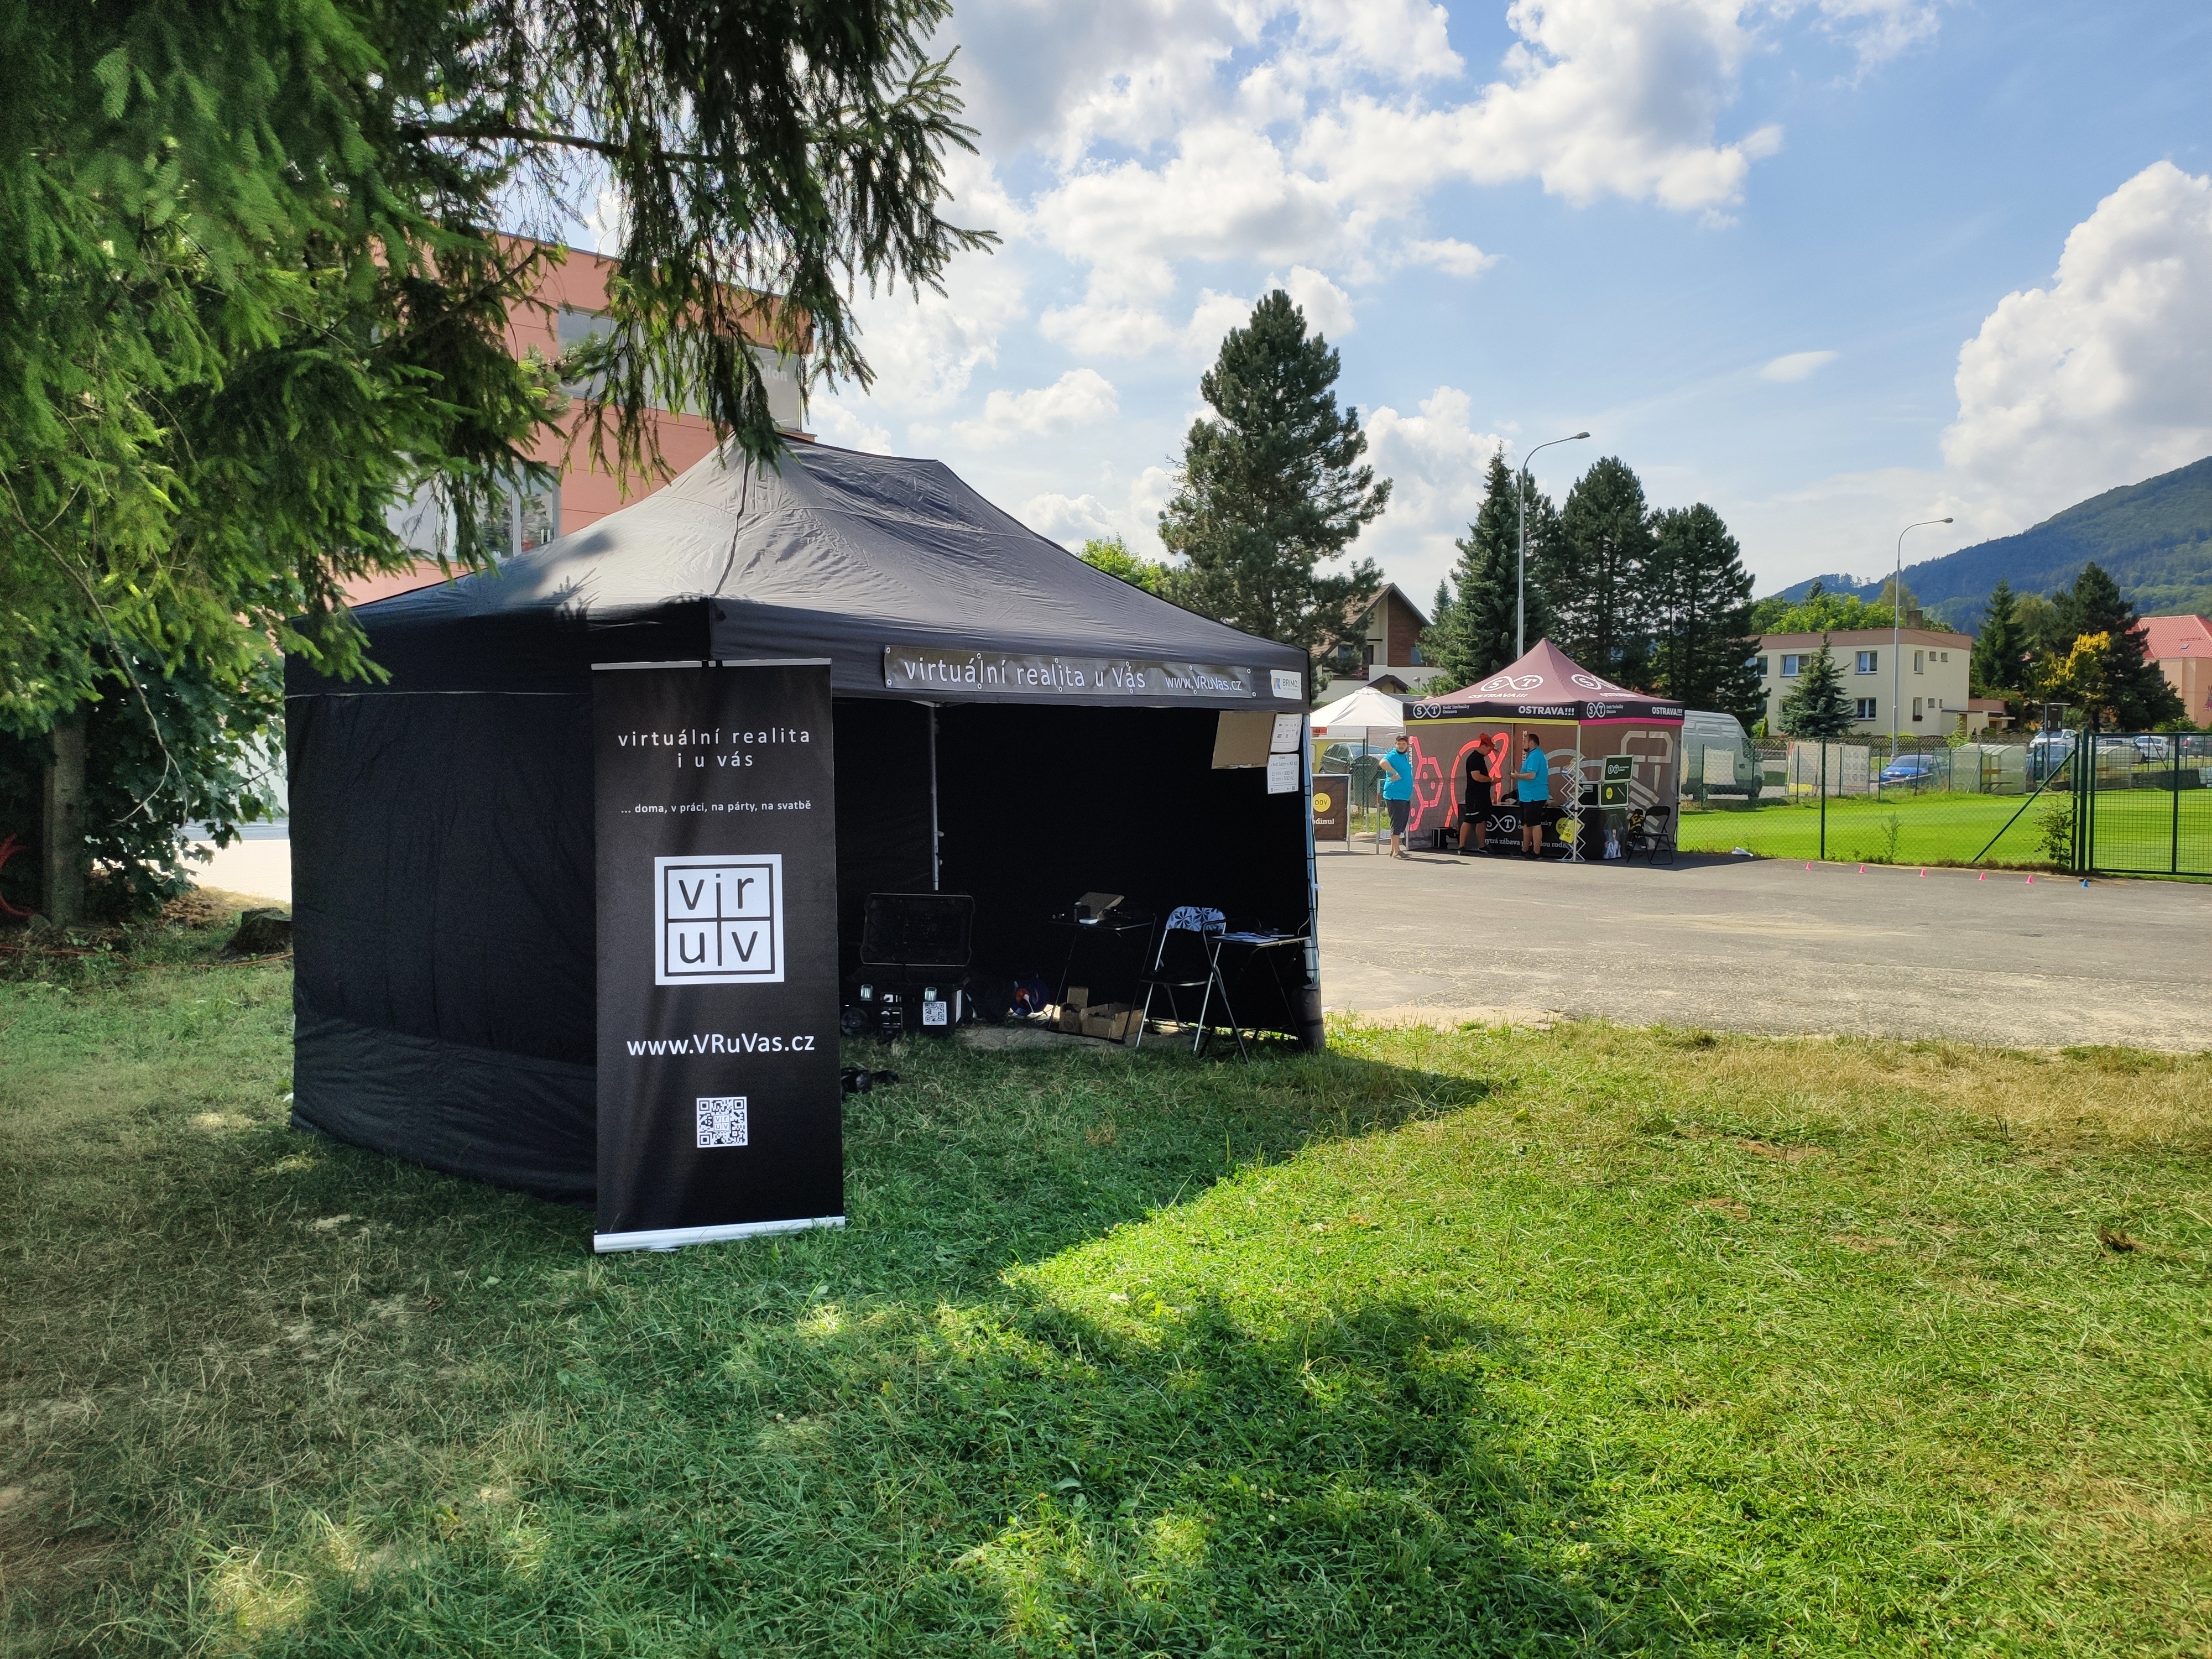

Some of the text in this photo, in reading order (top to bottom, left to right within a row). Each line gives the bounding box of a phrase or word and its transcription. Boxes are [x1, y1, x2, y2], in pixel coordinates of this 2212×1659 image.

[754, 363, 787, 382] alon
[904, 657, 1243, 691] virtuální realita u Vás www.VRuVas.cz
[1518, 706, 1575, 716] OSTRAVA!!!
[1651, 707, 1683, 716] OSTRAVA!!!
[618, 727, 810, 747] virtuální realita
[677, 751, 753, 768] i u vás
[635, 804, 667, 813] doma,
[680, 802, 707, 813] práci,
[728, 801, 758, 812] párty,
[777, 800, 811, 810] svatbě
[627, 1032, 815, 1056] www.VRuVas.cz
